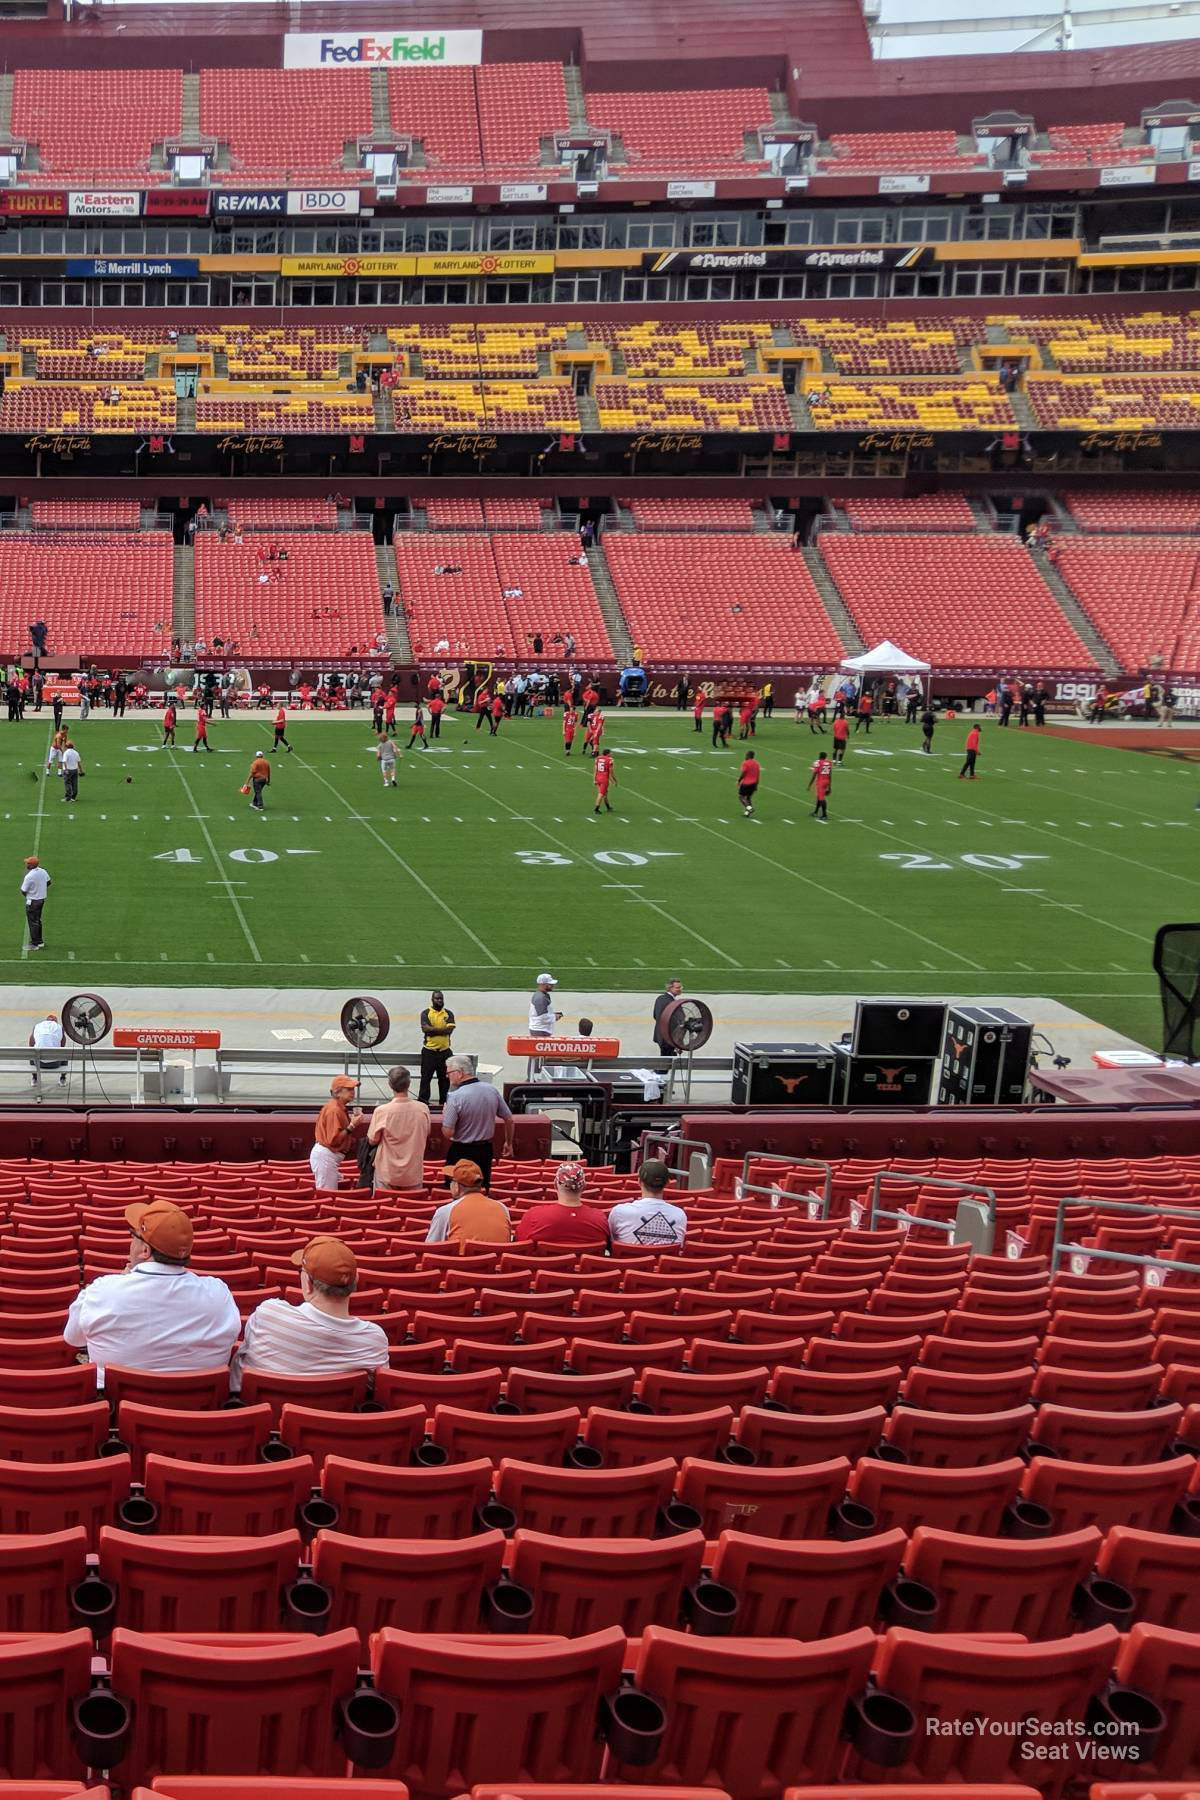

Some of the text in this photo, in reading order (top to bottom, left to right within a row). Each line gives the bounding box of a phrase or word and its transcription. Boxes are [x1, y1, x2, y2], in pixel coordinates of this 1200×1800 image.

[320, 36, 445, 62] FedExField
[218, 195, 281, 210] RE/MAX
[306, 192, 346, 208] BDO
[108, 262, 171, 275] Merrill Lynch
[298, 262, 398, 270] MARYLAND LOTTERY
[433, 260, 536, 269] MARYLAND LOTTERY
[1055, 683, 1097, 700] 1991
[136, 1034, 196, 1044] GATORADE
[535, 1042, 597, 1052] GATORADE
[876, 1083, 902, 1092] TEXAS
